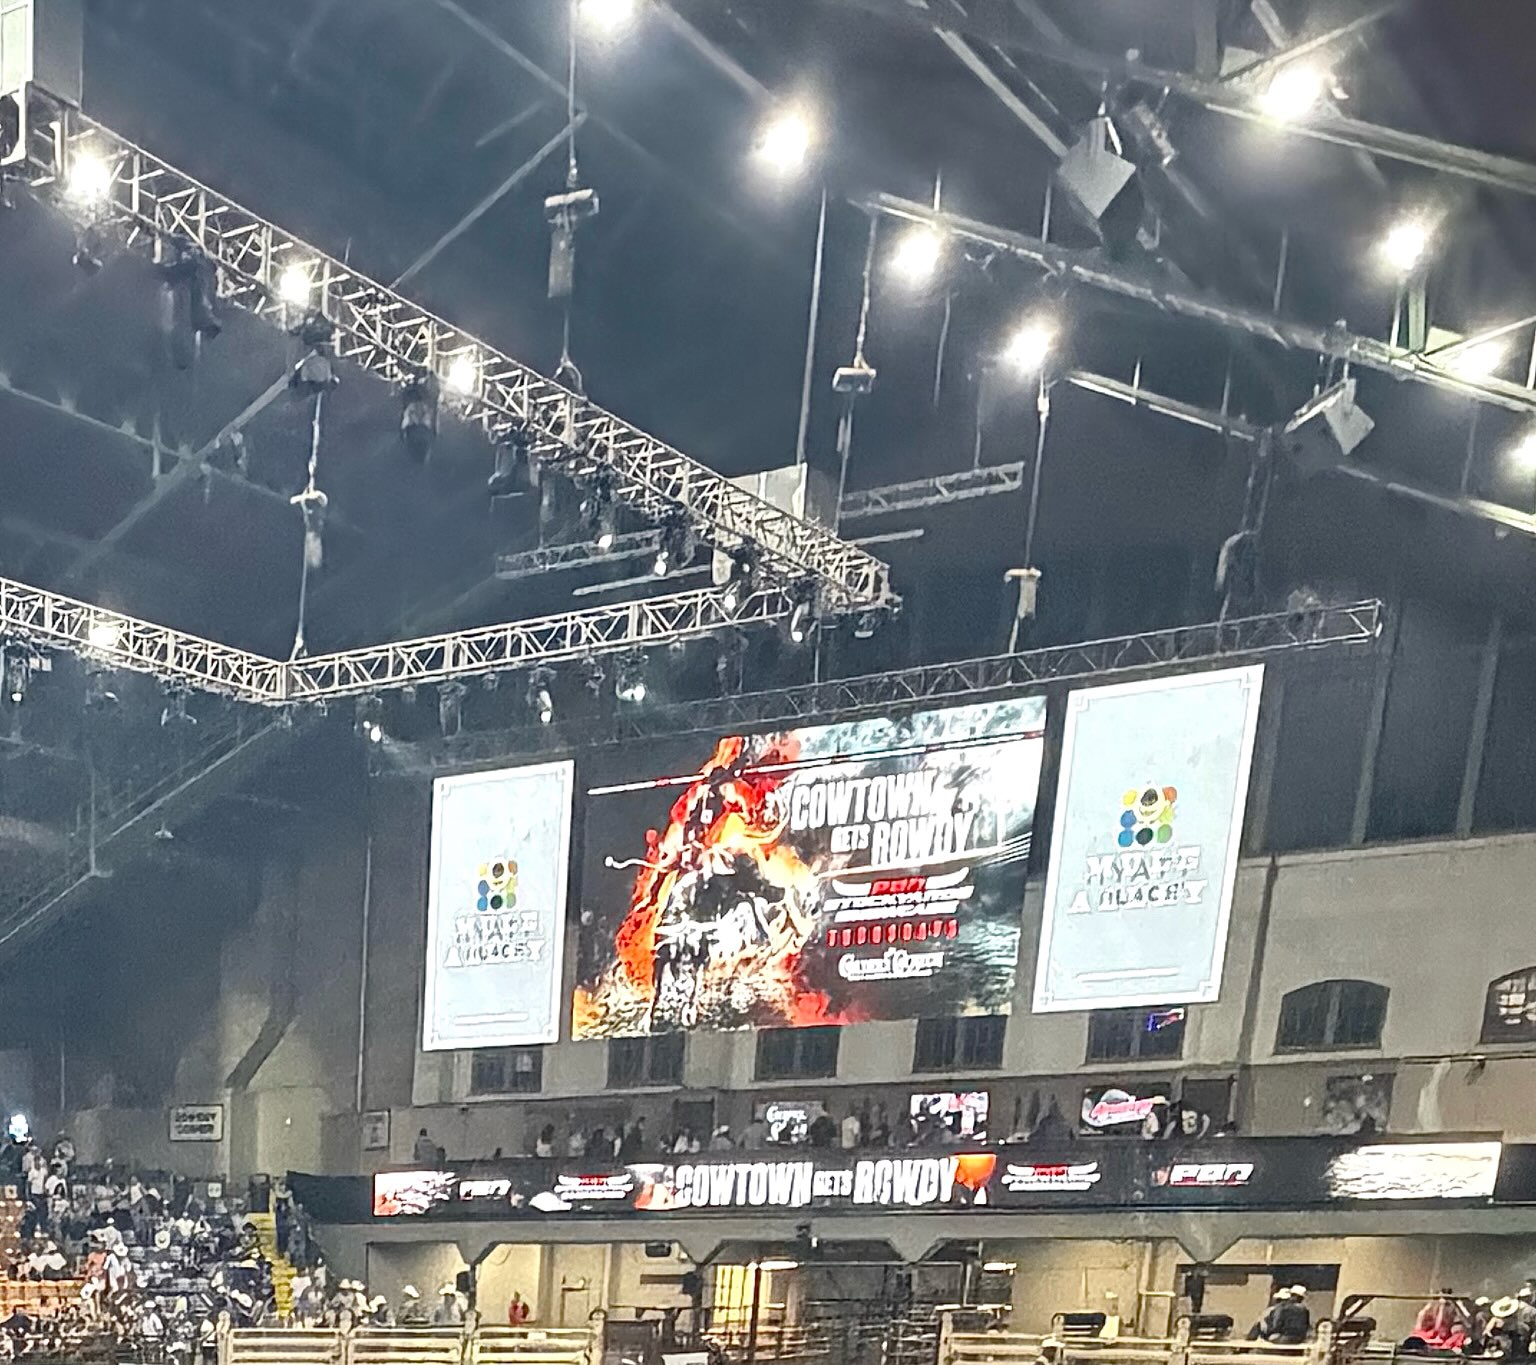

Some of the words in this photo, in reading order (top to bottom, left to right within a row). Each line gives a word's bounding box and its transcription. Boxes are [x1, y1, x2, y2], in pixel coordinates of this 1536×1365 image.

[675, 1162, 813, 1207] COWTOWN
[814, 1170, 853, 1196] GETS
[853, 1155, 961, 1205] ROWDY
